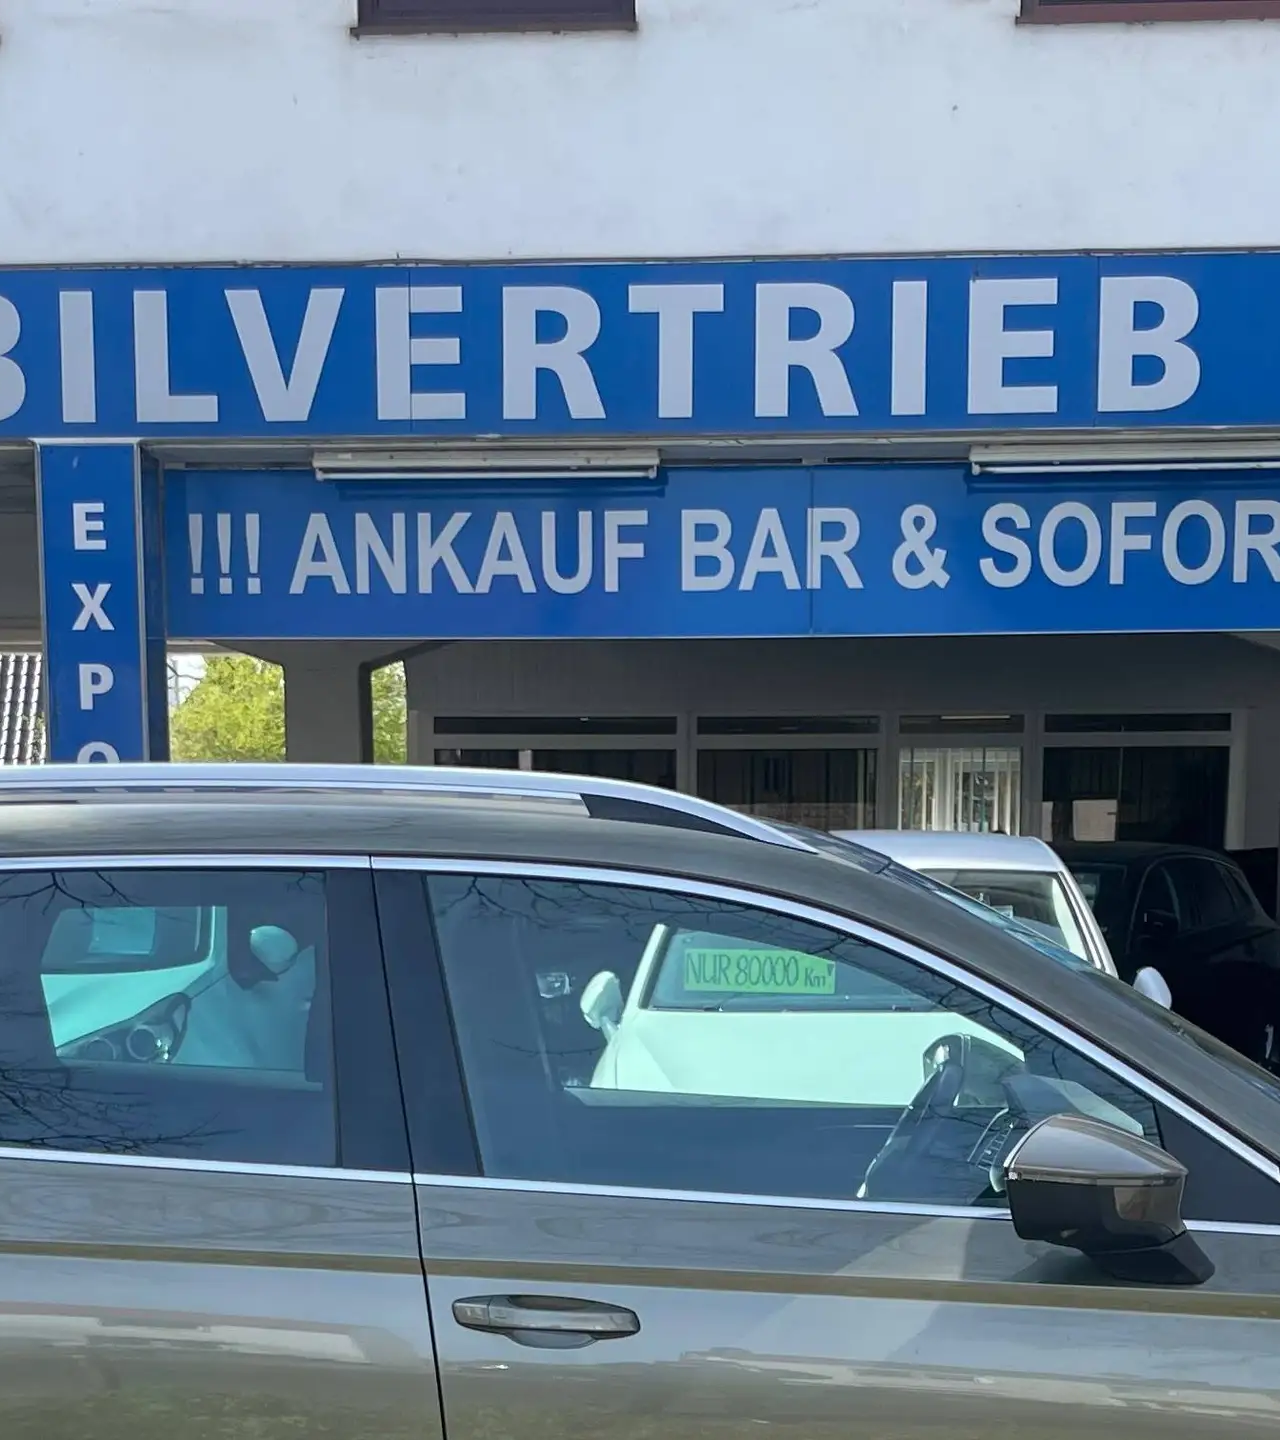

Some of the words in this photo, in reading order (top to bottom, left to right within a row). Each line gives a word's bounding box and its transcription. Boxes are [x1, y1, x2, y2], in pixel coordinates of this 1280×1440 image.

[188, 513, 262, 594] !!!
[289, 509, 649, 595] ANKAUF
[680, 507, 865, 592] BAR
[891, 503, 948, 590] &
[685, 952, 731, 985] NUR
[735, 955, 800, 987] 80000
